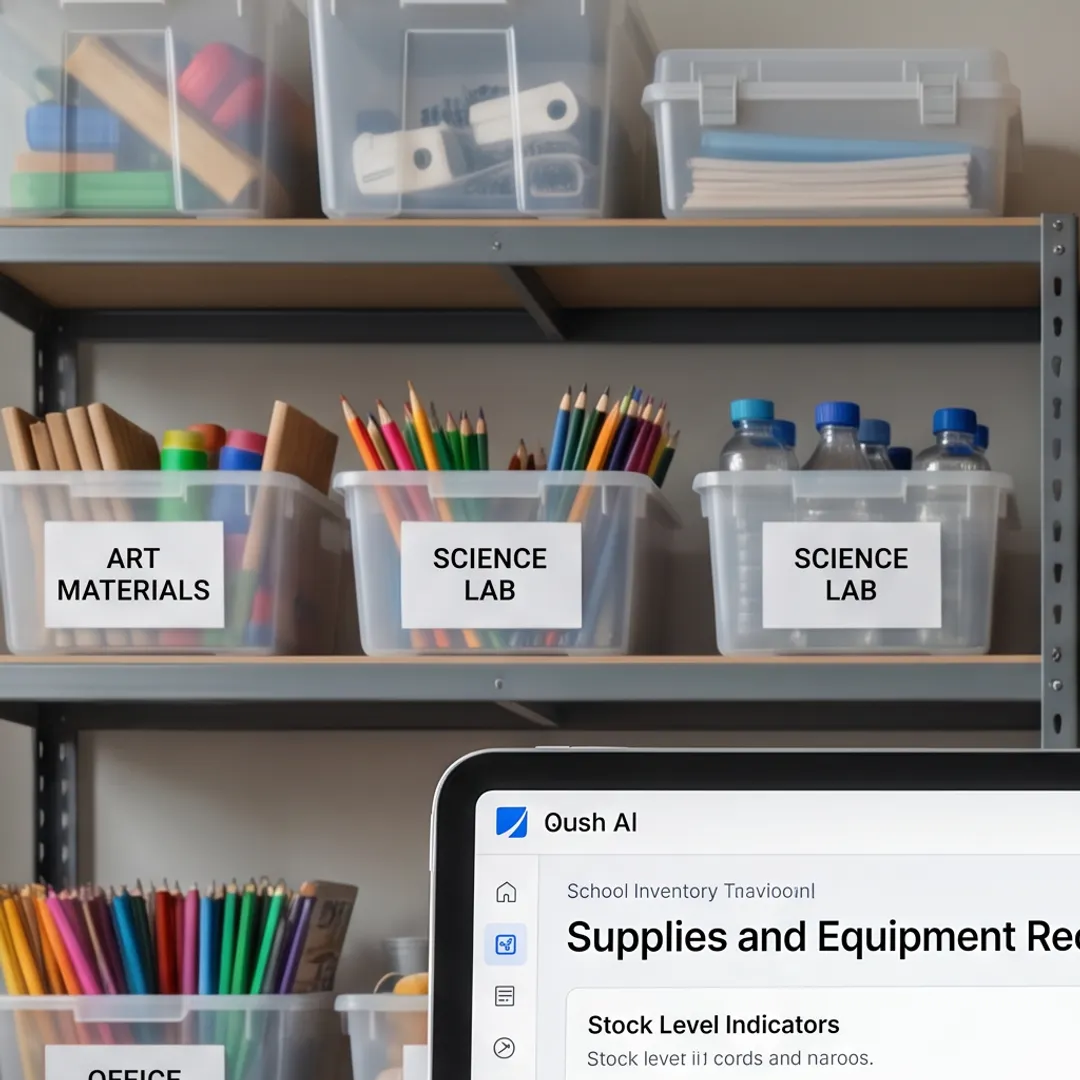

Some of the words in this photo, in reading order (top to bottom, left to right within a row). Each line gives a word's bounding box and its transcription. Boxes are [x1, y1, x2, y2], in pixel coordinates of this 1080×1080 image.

[106, 547, 161, 569] ART
[433, 547, 547, 569] SCIENCE
[794, 547, 909, 570] SCIENCE
[57, 578, 210, 601] MATERIALS
[465, 579, 516, 601] LAB
[826, 579, 877, 601] LAB
[567, 882, 628, 899] School
[634, 883, 719, 903] Inventory
[567, 919, 728, 961] Supplies
[737, 919, 806, 953] and
[818, 918, 1016, 960] Equipment
[588, 1014, 653, 1035] Stock
[660, 1014, 719, 1035] Level
[726, 1013, 840, 1035] Indicators
[587, 1050, 639, 1067] Stock
[713, 1050, 763, 1067] cords
[768, 1049, 801, 1066] and
[807, 1053, 874, 1066] naroos.
